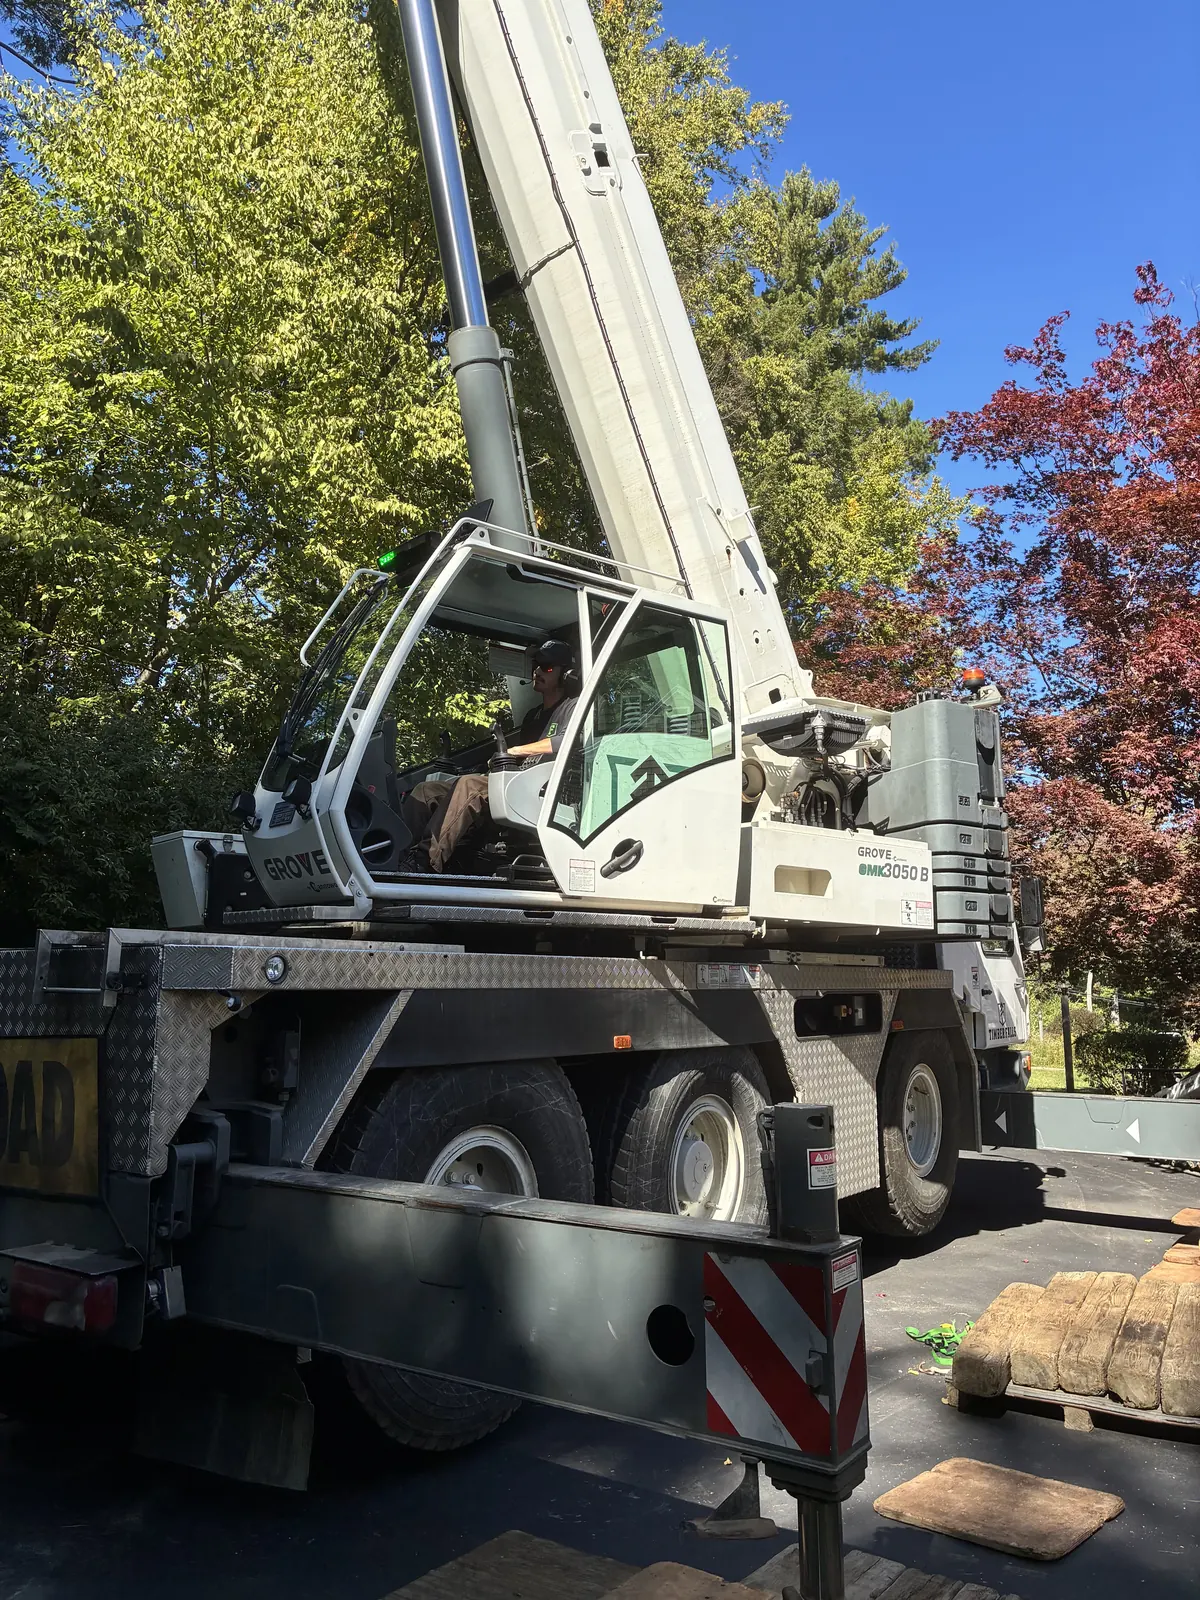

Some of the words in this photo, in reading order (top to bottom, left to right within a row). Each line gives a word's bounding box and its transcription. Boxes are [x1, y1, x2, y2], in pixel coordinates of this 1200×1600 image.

[263, 849, 331, 880] GROVE
[857, 846, 892, 860] GROVE
[920, 866, 929, 882] B
[0, 1060, 75, 1167] AD
